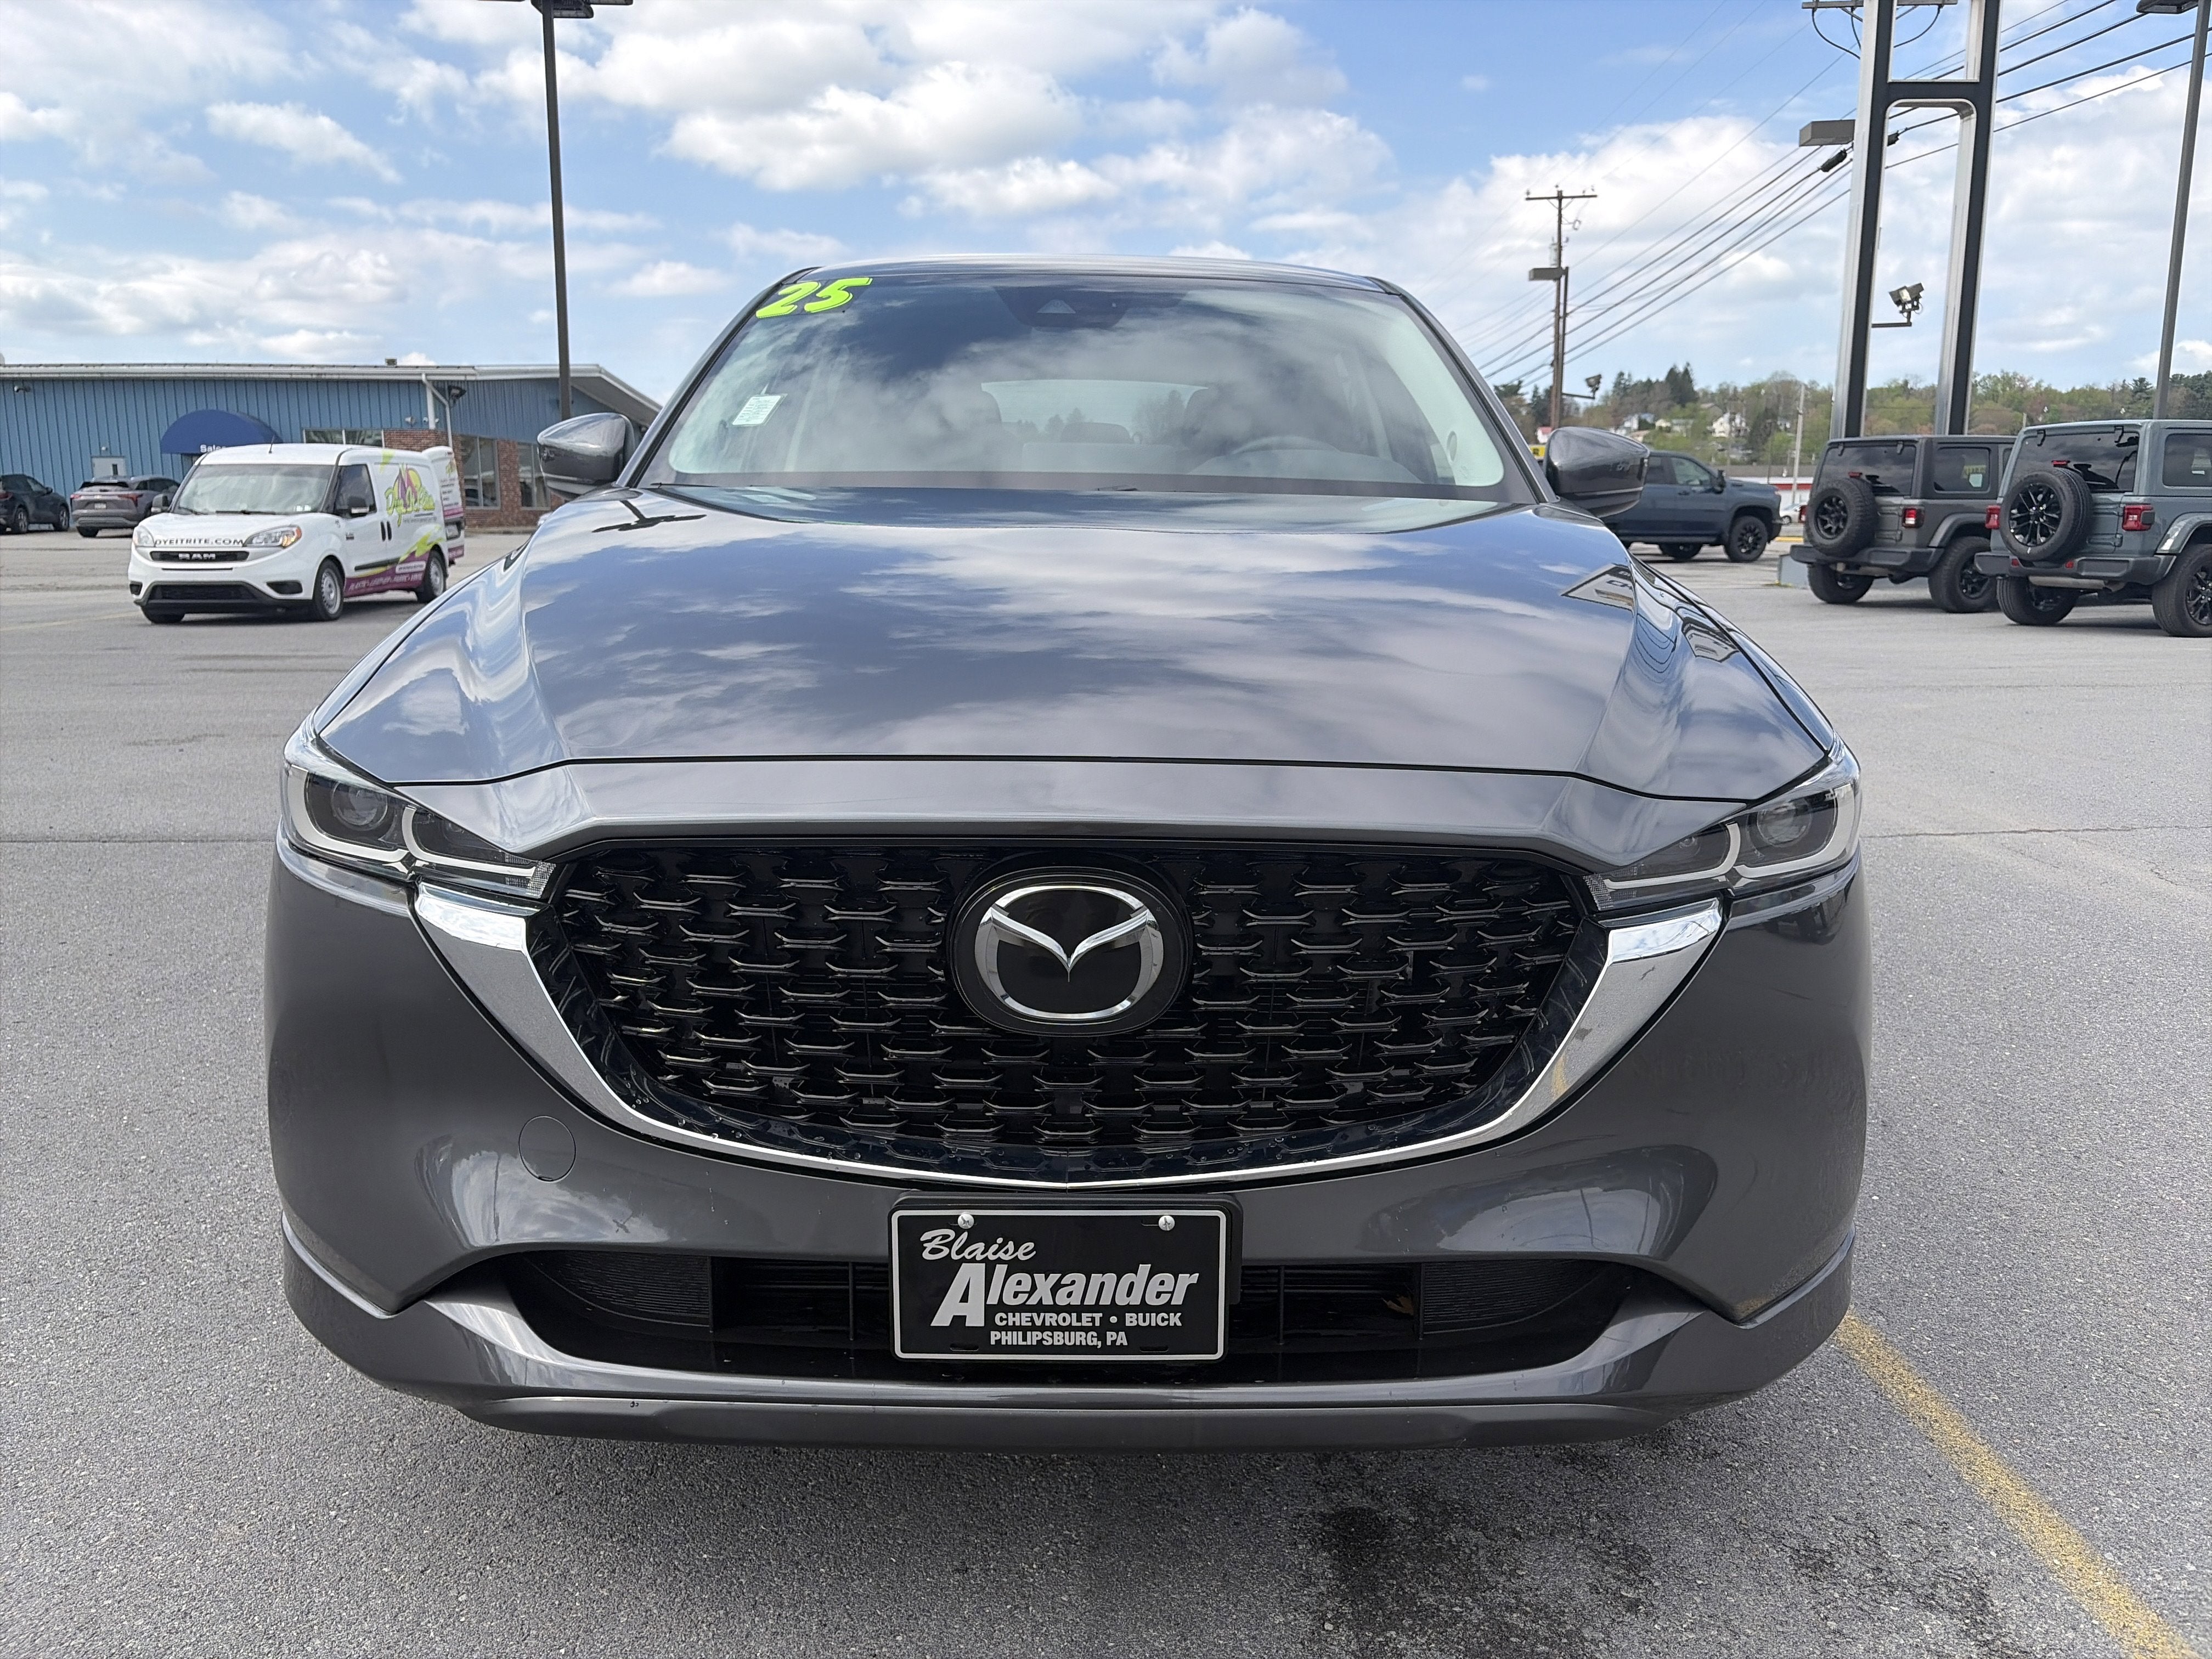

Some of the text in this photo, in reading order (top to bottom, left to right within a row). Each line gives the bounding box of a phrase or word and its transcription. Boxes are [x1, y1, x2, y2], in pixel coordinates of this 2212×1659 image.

[756, 277, 873, 319] 25
[920, 1229, 1036, 1261] Blaise
[930, 1263, 1199, 1327] Alexander
[995, 1312, 1182, 1327] CHEVROLET BUICK
[990, 1331, 1127, 1348] PHILIPSBURG, PA
